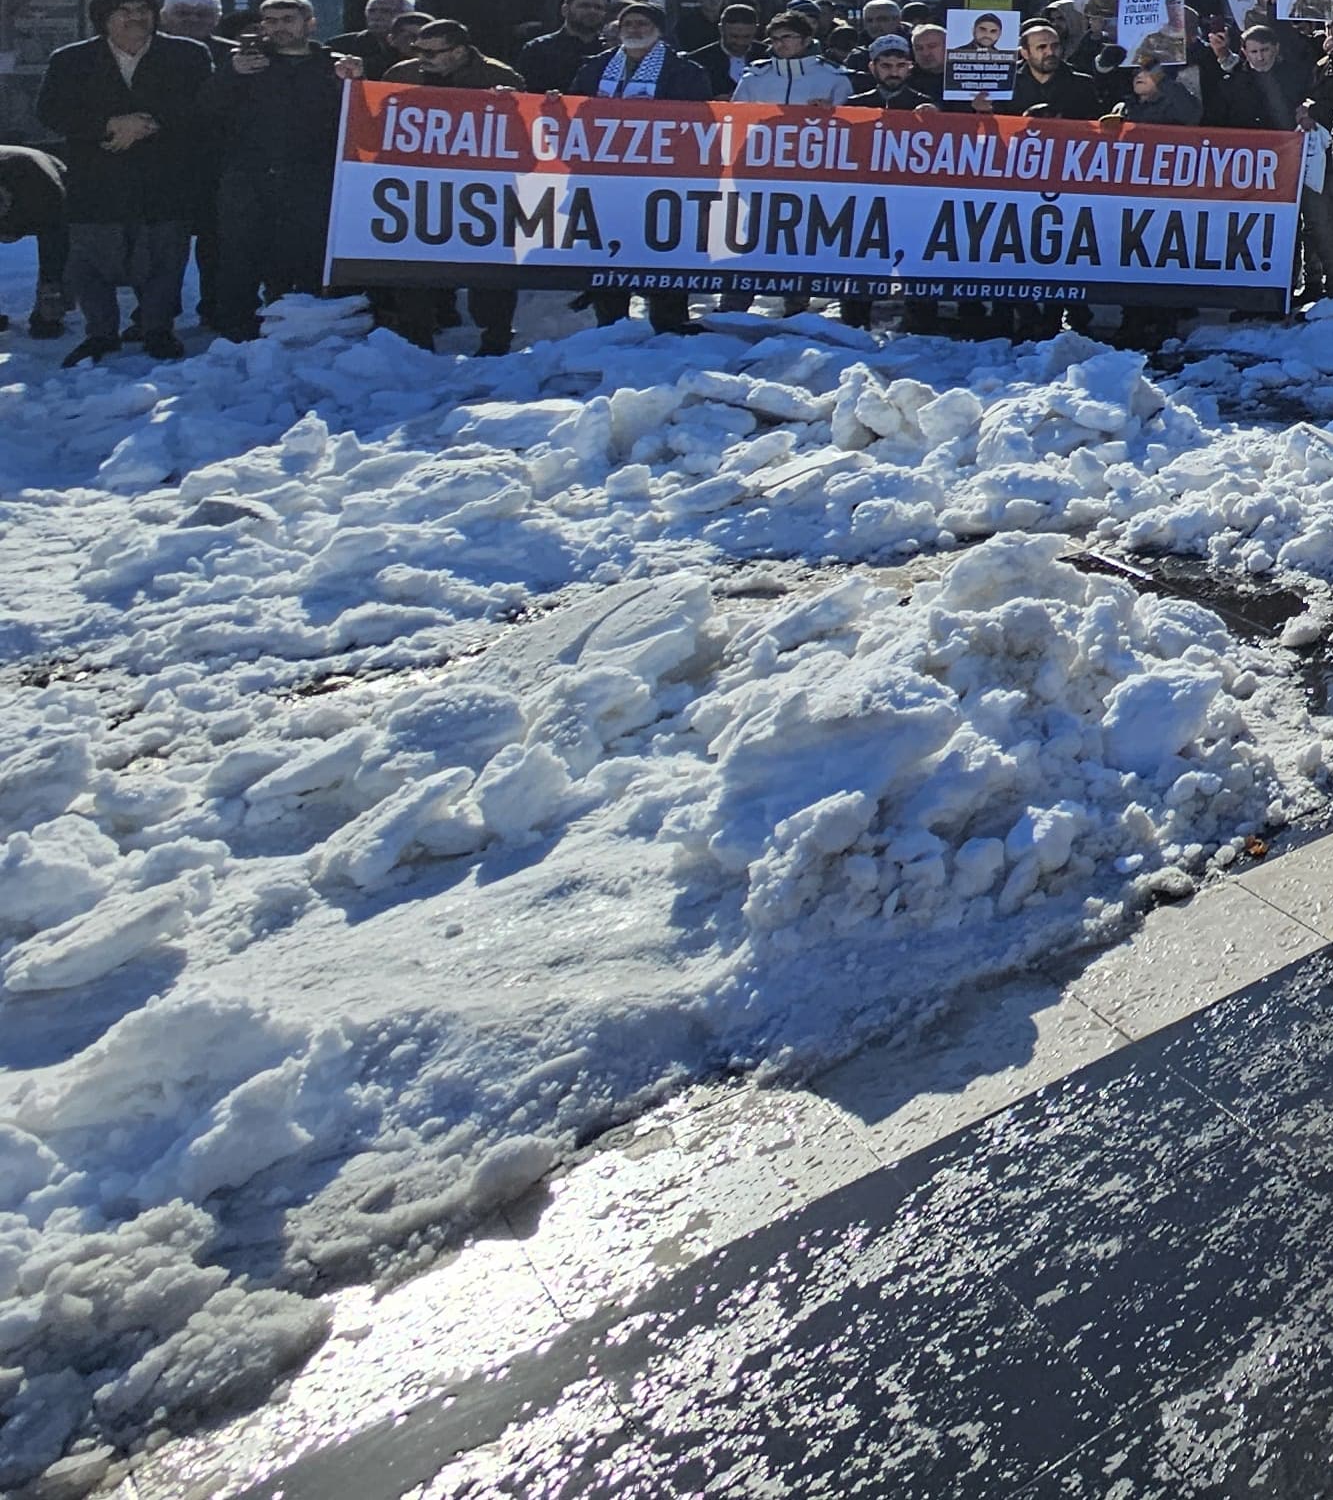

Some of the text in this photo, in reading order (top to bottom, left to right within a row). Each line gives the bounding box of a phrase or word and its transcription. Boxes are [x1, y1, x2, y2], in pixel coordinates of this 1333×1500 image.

[382, 97, 1278, 190] İSRAİL GAZZE'Yİ DEĞİL İNSANLIĞI KATLEDİYOR
[370, 177, 1277, 272] SUSMA, OTURMA, AYAĞA KALK!
[591, 271, 1087, 301] DİYARBAKIR İSLAMİ SİVİL TOPLUM KURULUŞLARI
